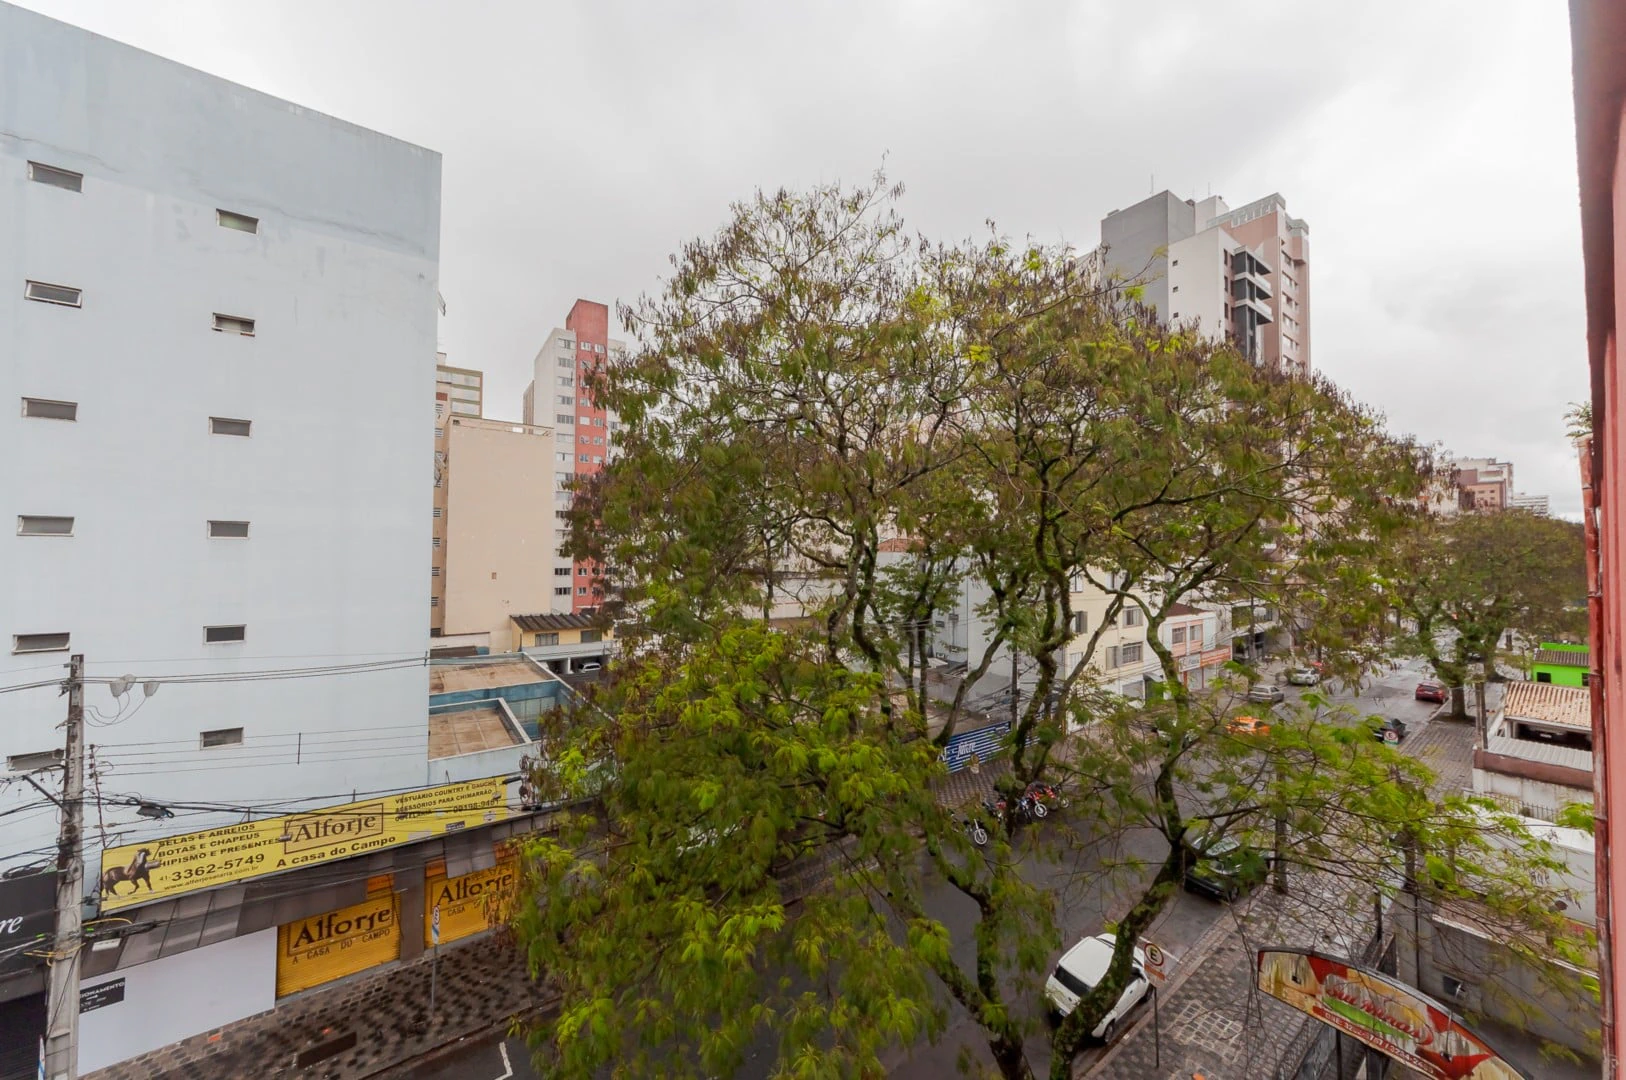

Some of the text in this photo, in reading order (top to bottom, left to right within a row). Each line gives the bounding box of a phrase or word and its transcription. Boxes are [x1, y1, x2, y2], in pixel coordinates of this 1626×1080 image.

[434, 786, 464, 797] COUNTRY
[159, 834, 195, 848] SELAS
[208, 824, 256, 838] ARREIOS
[292, 814, 377, 843] Alforje
[158, 832, 260, 858] BOTAS E CHAPEUS
[159, 853, 207, 868] HIPISMO
[220, 837, 280, 855] PRESENTES
[276, 836, 396, 868] A casa do Campo
[293, 907, 391, 949] Alforje
[291, 928, 391, 965] A CASA DO CAMPO
[1150, 947, 1159, 962] E
